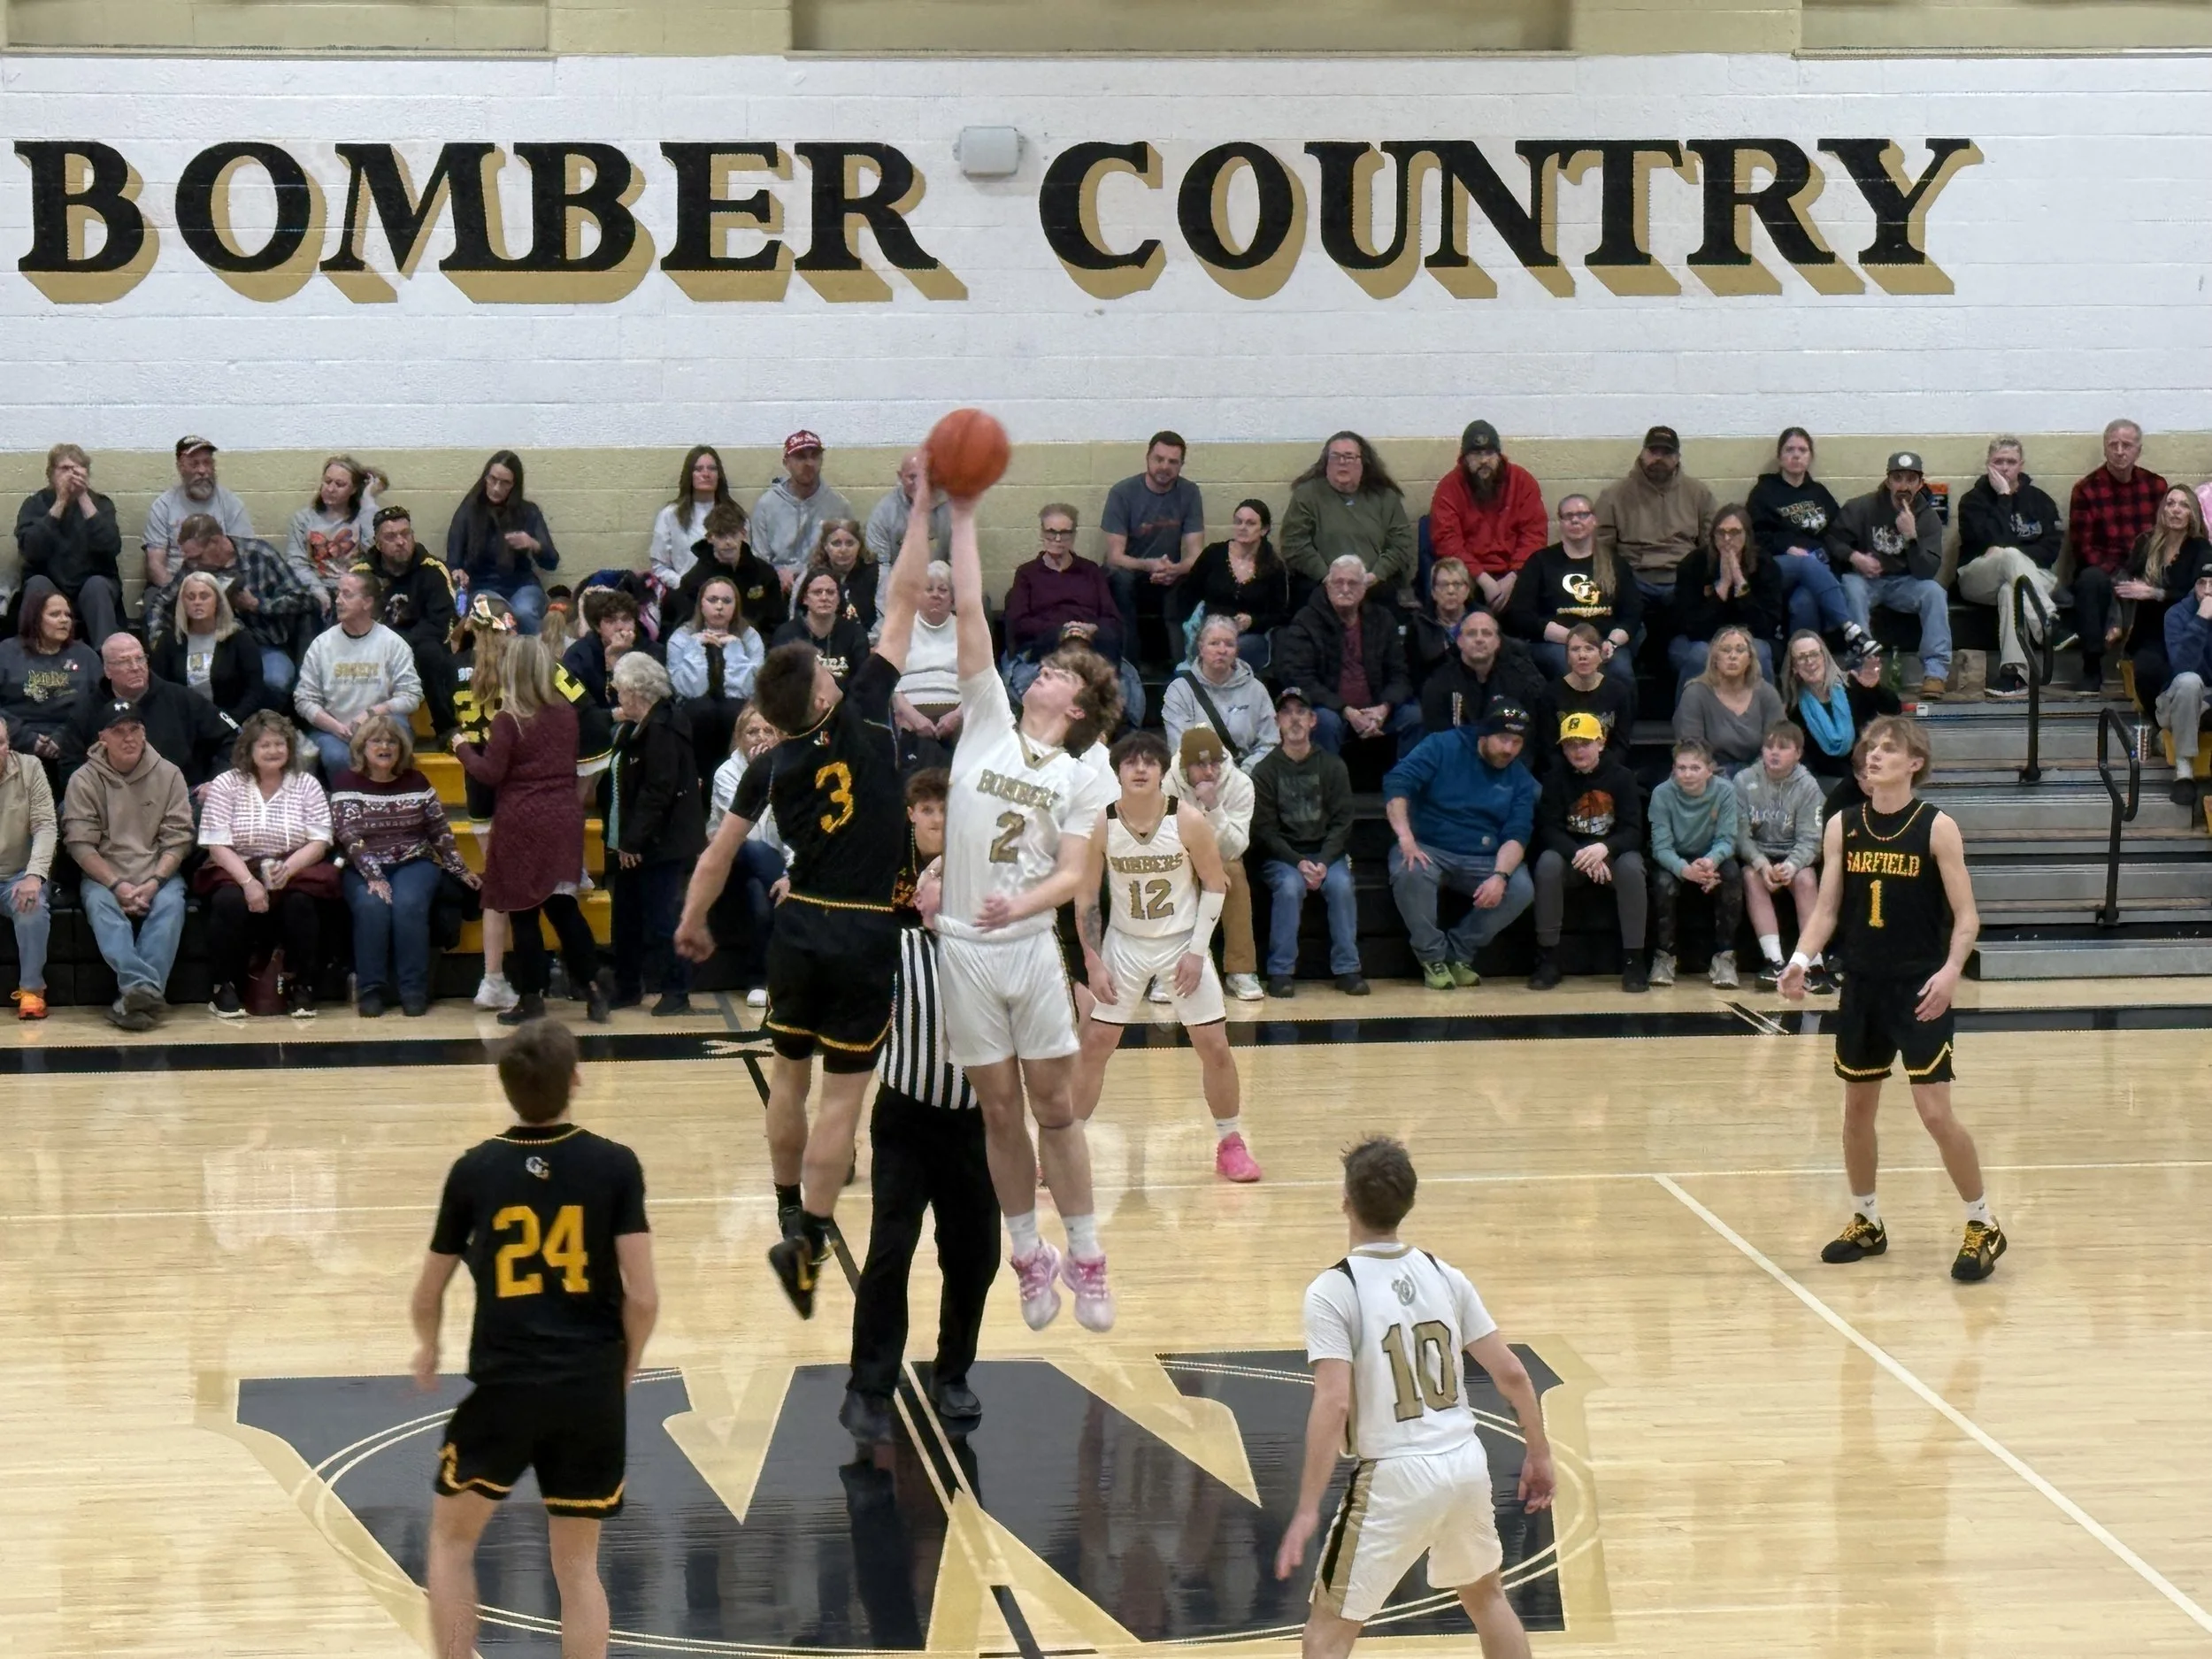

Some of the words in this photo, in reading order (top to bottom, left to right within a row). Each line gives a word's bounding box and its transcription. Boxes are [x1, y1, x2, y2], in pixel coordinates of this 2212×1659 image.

[13, 140, 968, 303] BOMBER
[1039, 136, 1985, 299] COUNTRY
[815, 762, 854, 833] 3
[989, 810, 1026, 864] 2
[1128, 879, 1175, 920] 12
[1869, 879, 1885, 928] 1
[492, 1205, 590, 1298] 24
[1380, 1319, 1459, 1423] 10
